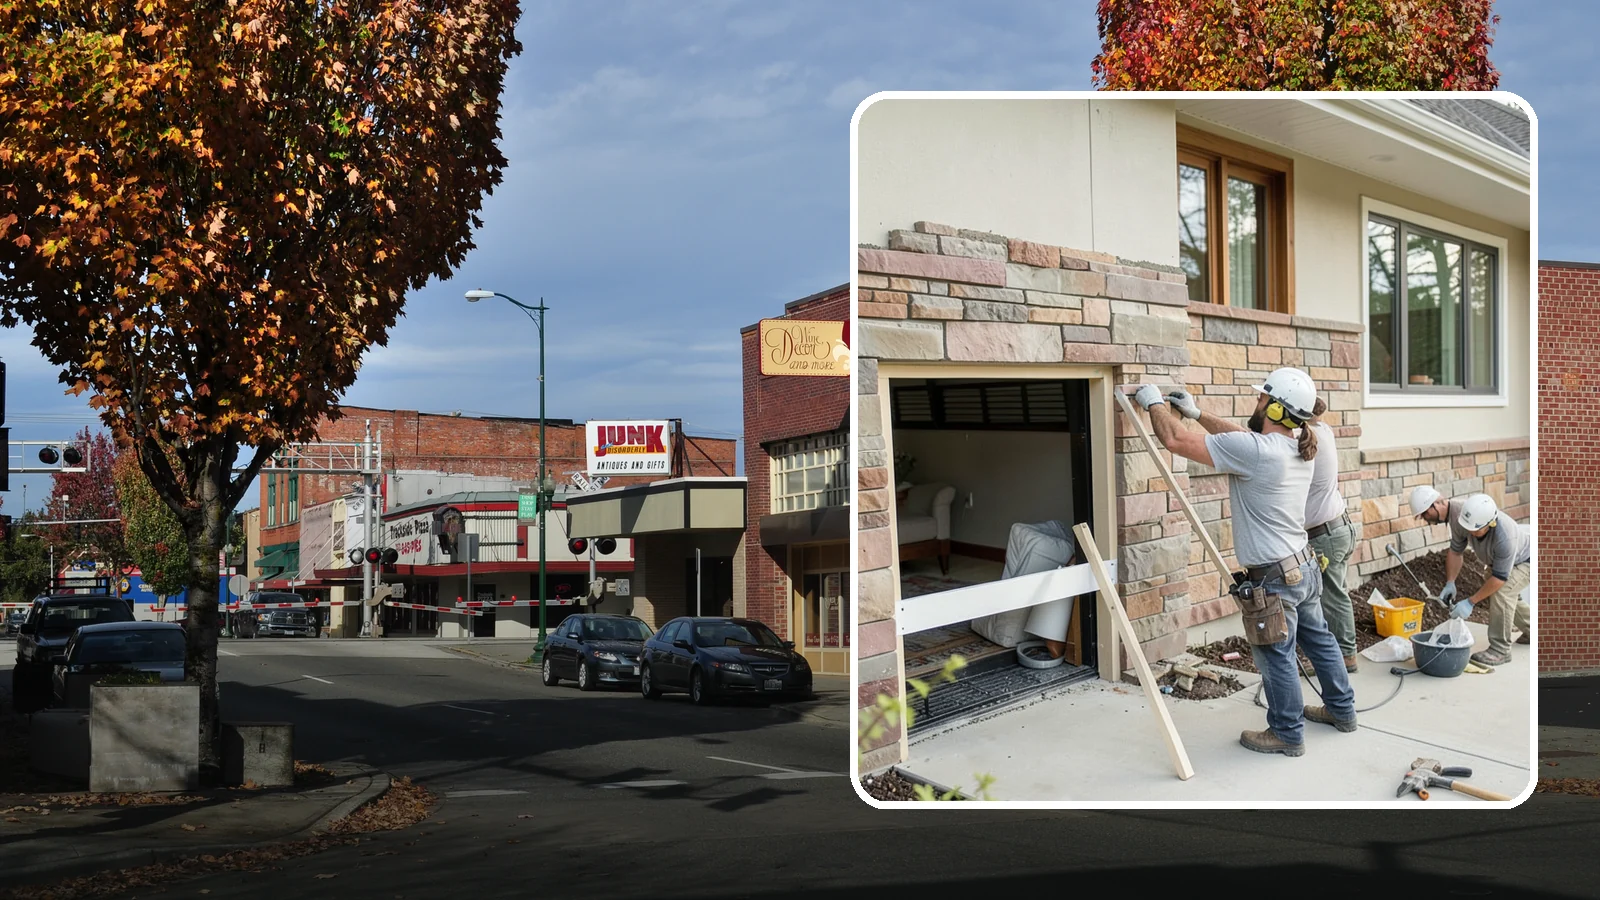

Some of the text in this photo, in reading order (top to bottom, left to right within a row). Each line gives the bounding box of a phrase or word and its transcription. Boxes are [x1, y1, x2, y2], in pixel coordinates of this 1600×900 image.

[765, 328, 831, 365] Decor
[595, 425, 665, 457] JUNK
[607, 445, 646, 454] DISORDERLY
[597, 460, 665, 470] ANTIQUES AND GIFTS
[414, 519, 429, 535] Pizza
